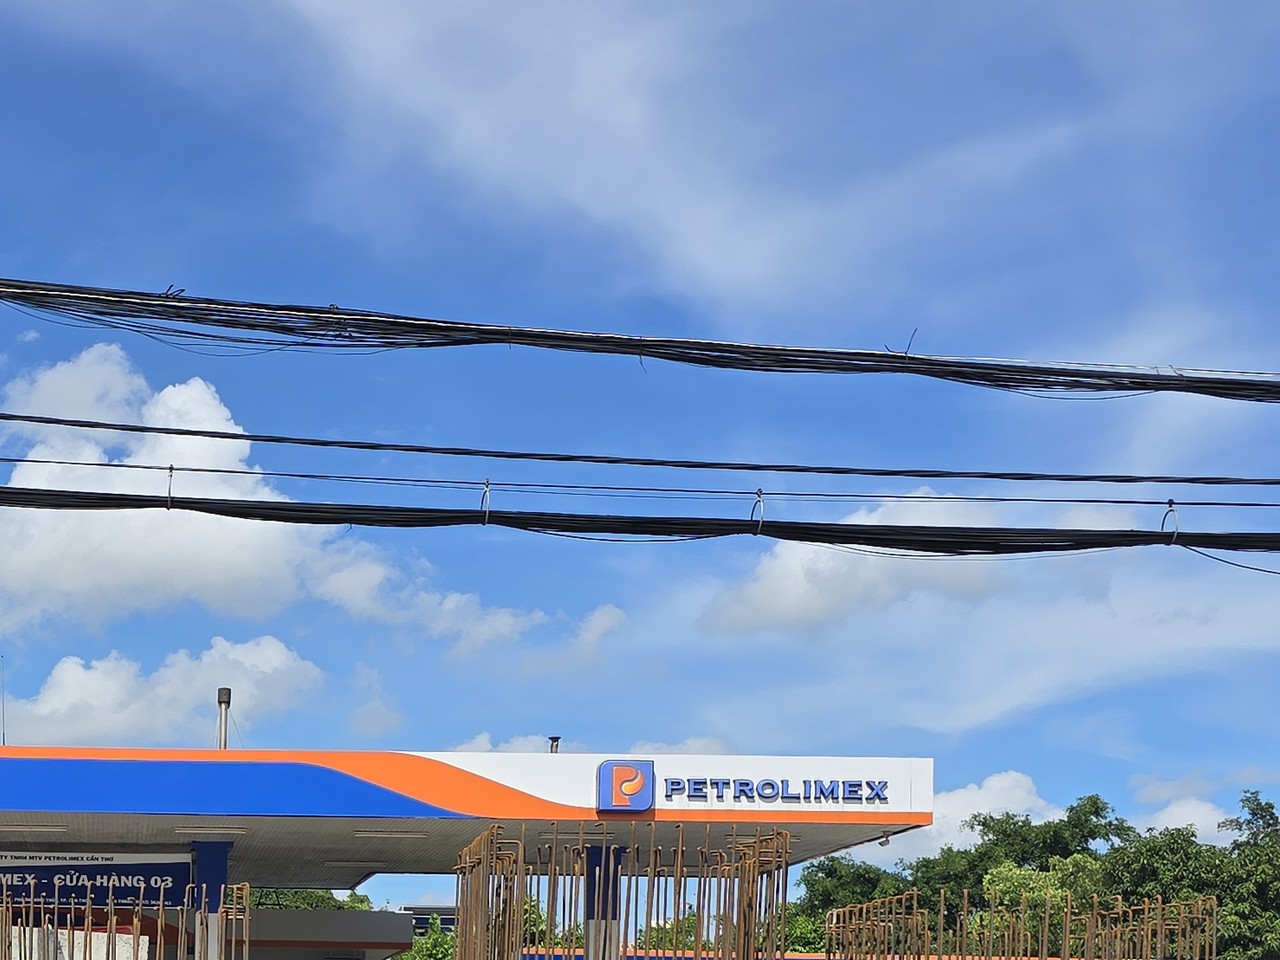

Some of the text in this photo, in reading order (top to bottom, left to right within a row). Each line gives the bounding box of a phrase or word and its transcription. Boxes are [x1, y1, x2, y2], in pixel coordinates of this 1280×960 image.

[665, 778, 889, 804] PETROLIMEX
[53, 870, 89, 887] CỬA
[96, 872, 145, 887] HÀNG
[150, 876, 173, 888] 03
